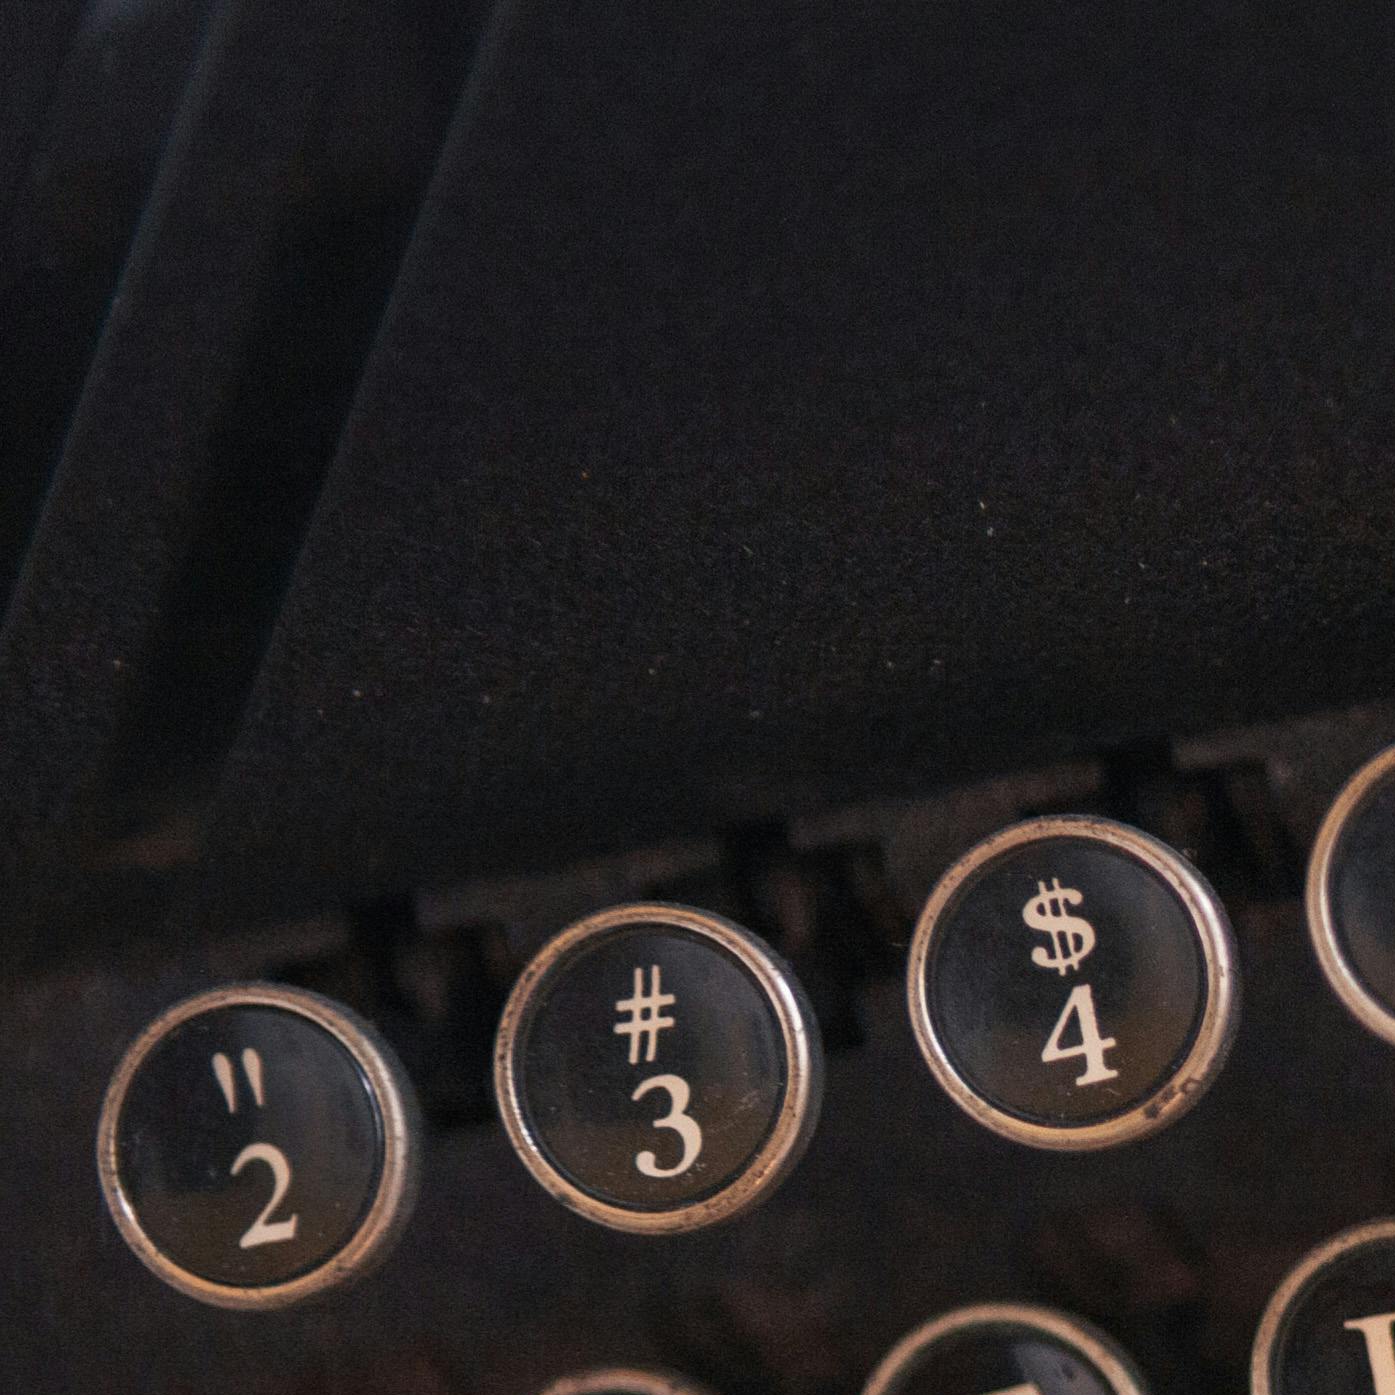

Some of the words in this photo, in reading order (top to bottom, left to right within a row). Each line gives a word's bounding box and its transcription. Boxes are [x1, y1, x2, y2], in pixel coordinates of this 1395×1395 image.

[1023, 879, 1096, 975] $
[615, 966, 675, 1063] #
[1041, 984, 1118, 1086] 4
[633, 1074, 702, 1178] 3
[232, 1143, 297, 1248] 2
